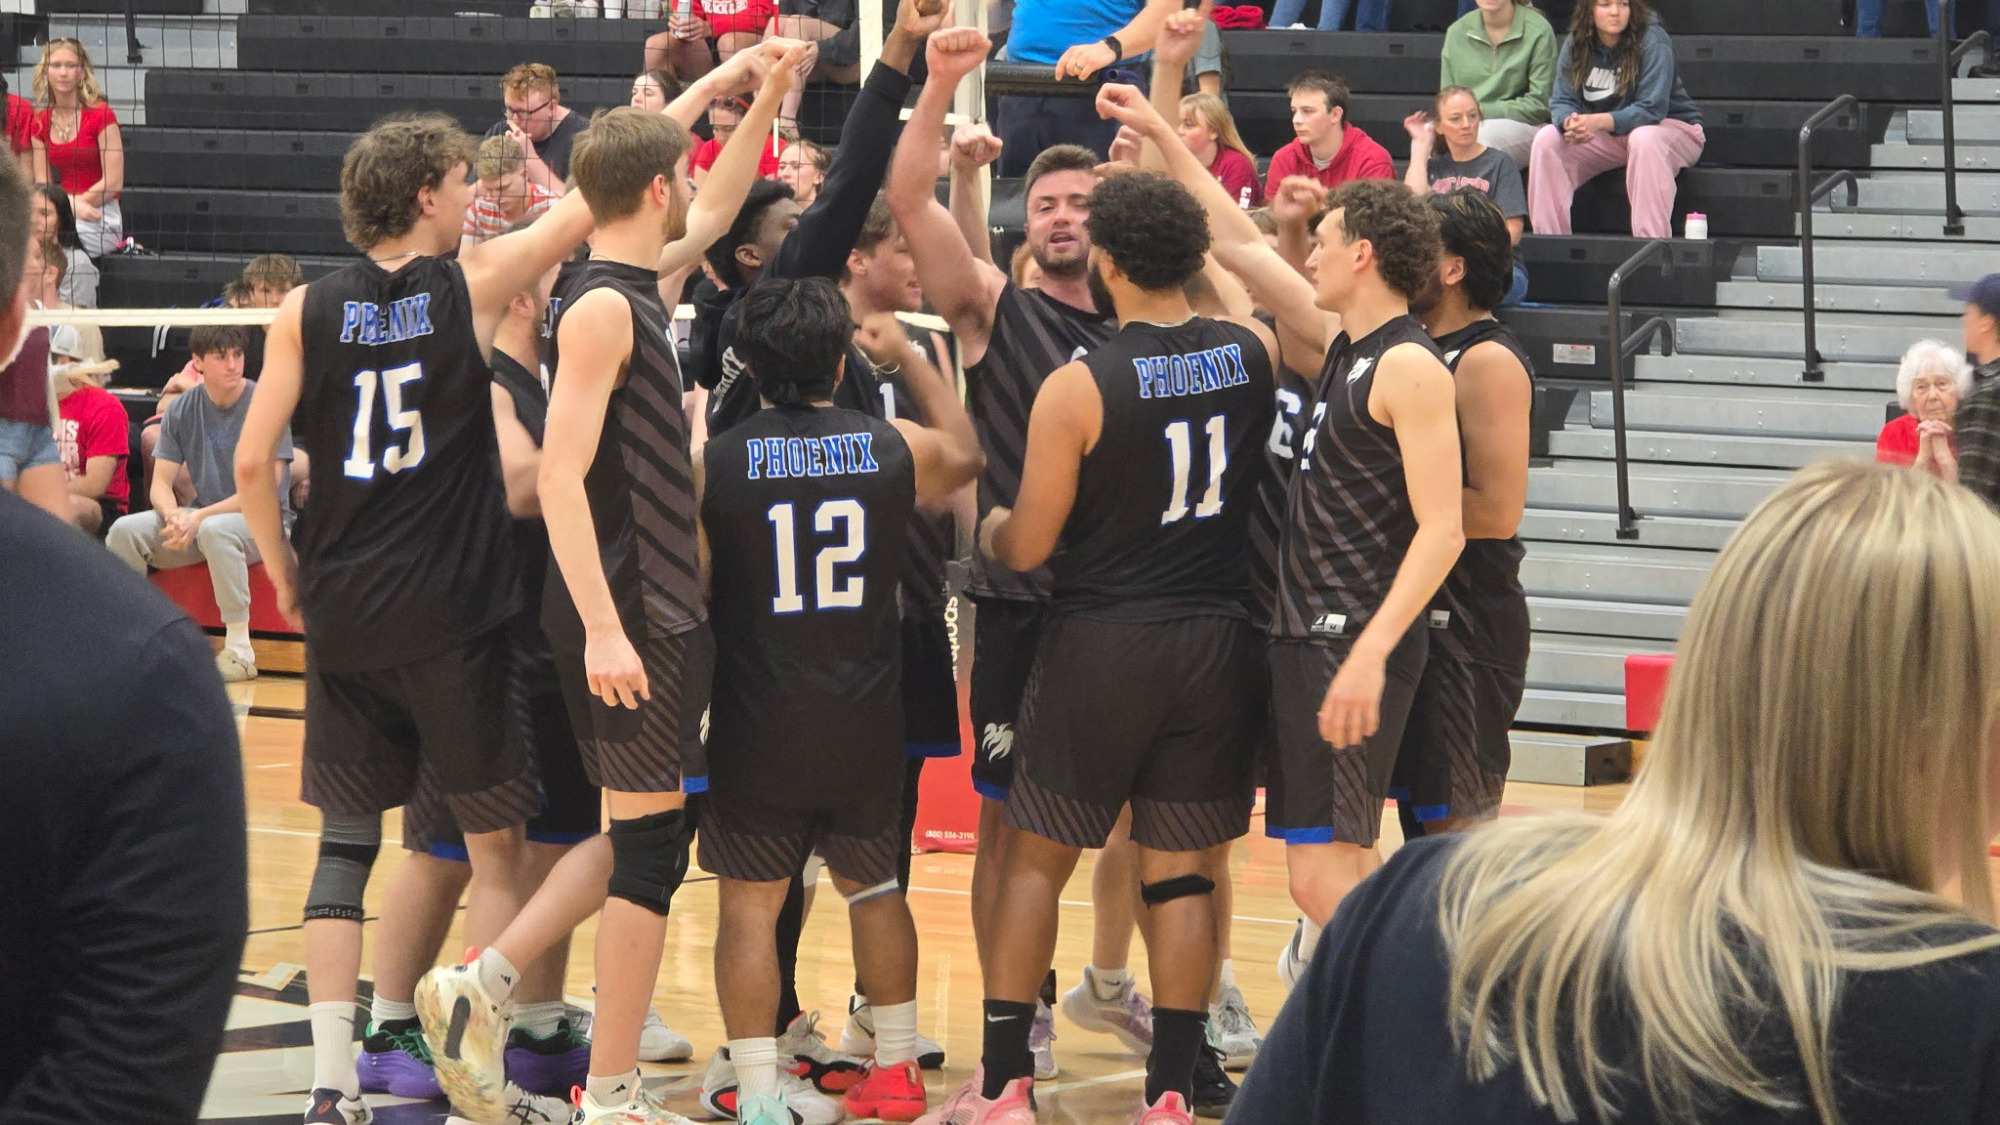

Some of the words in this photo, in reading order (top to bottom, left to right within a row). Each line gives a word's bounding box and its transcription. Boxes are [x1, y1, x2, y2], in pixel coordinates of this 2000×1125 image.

[343, 361, 426, 479] 15
[1132, 343, 1250, 398] PHOENIX
[747, 432, 879, 479] PHOENIX
[1160, 412, 1228, 525] 11
[767, 497, 867, 615] 12
